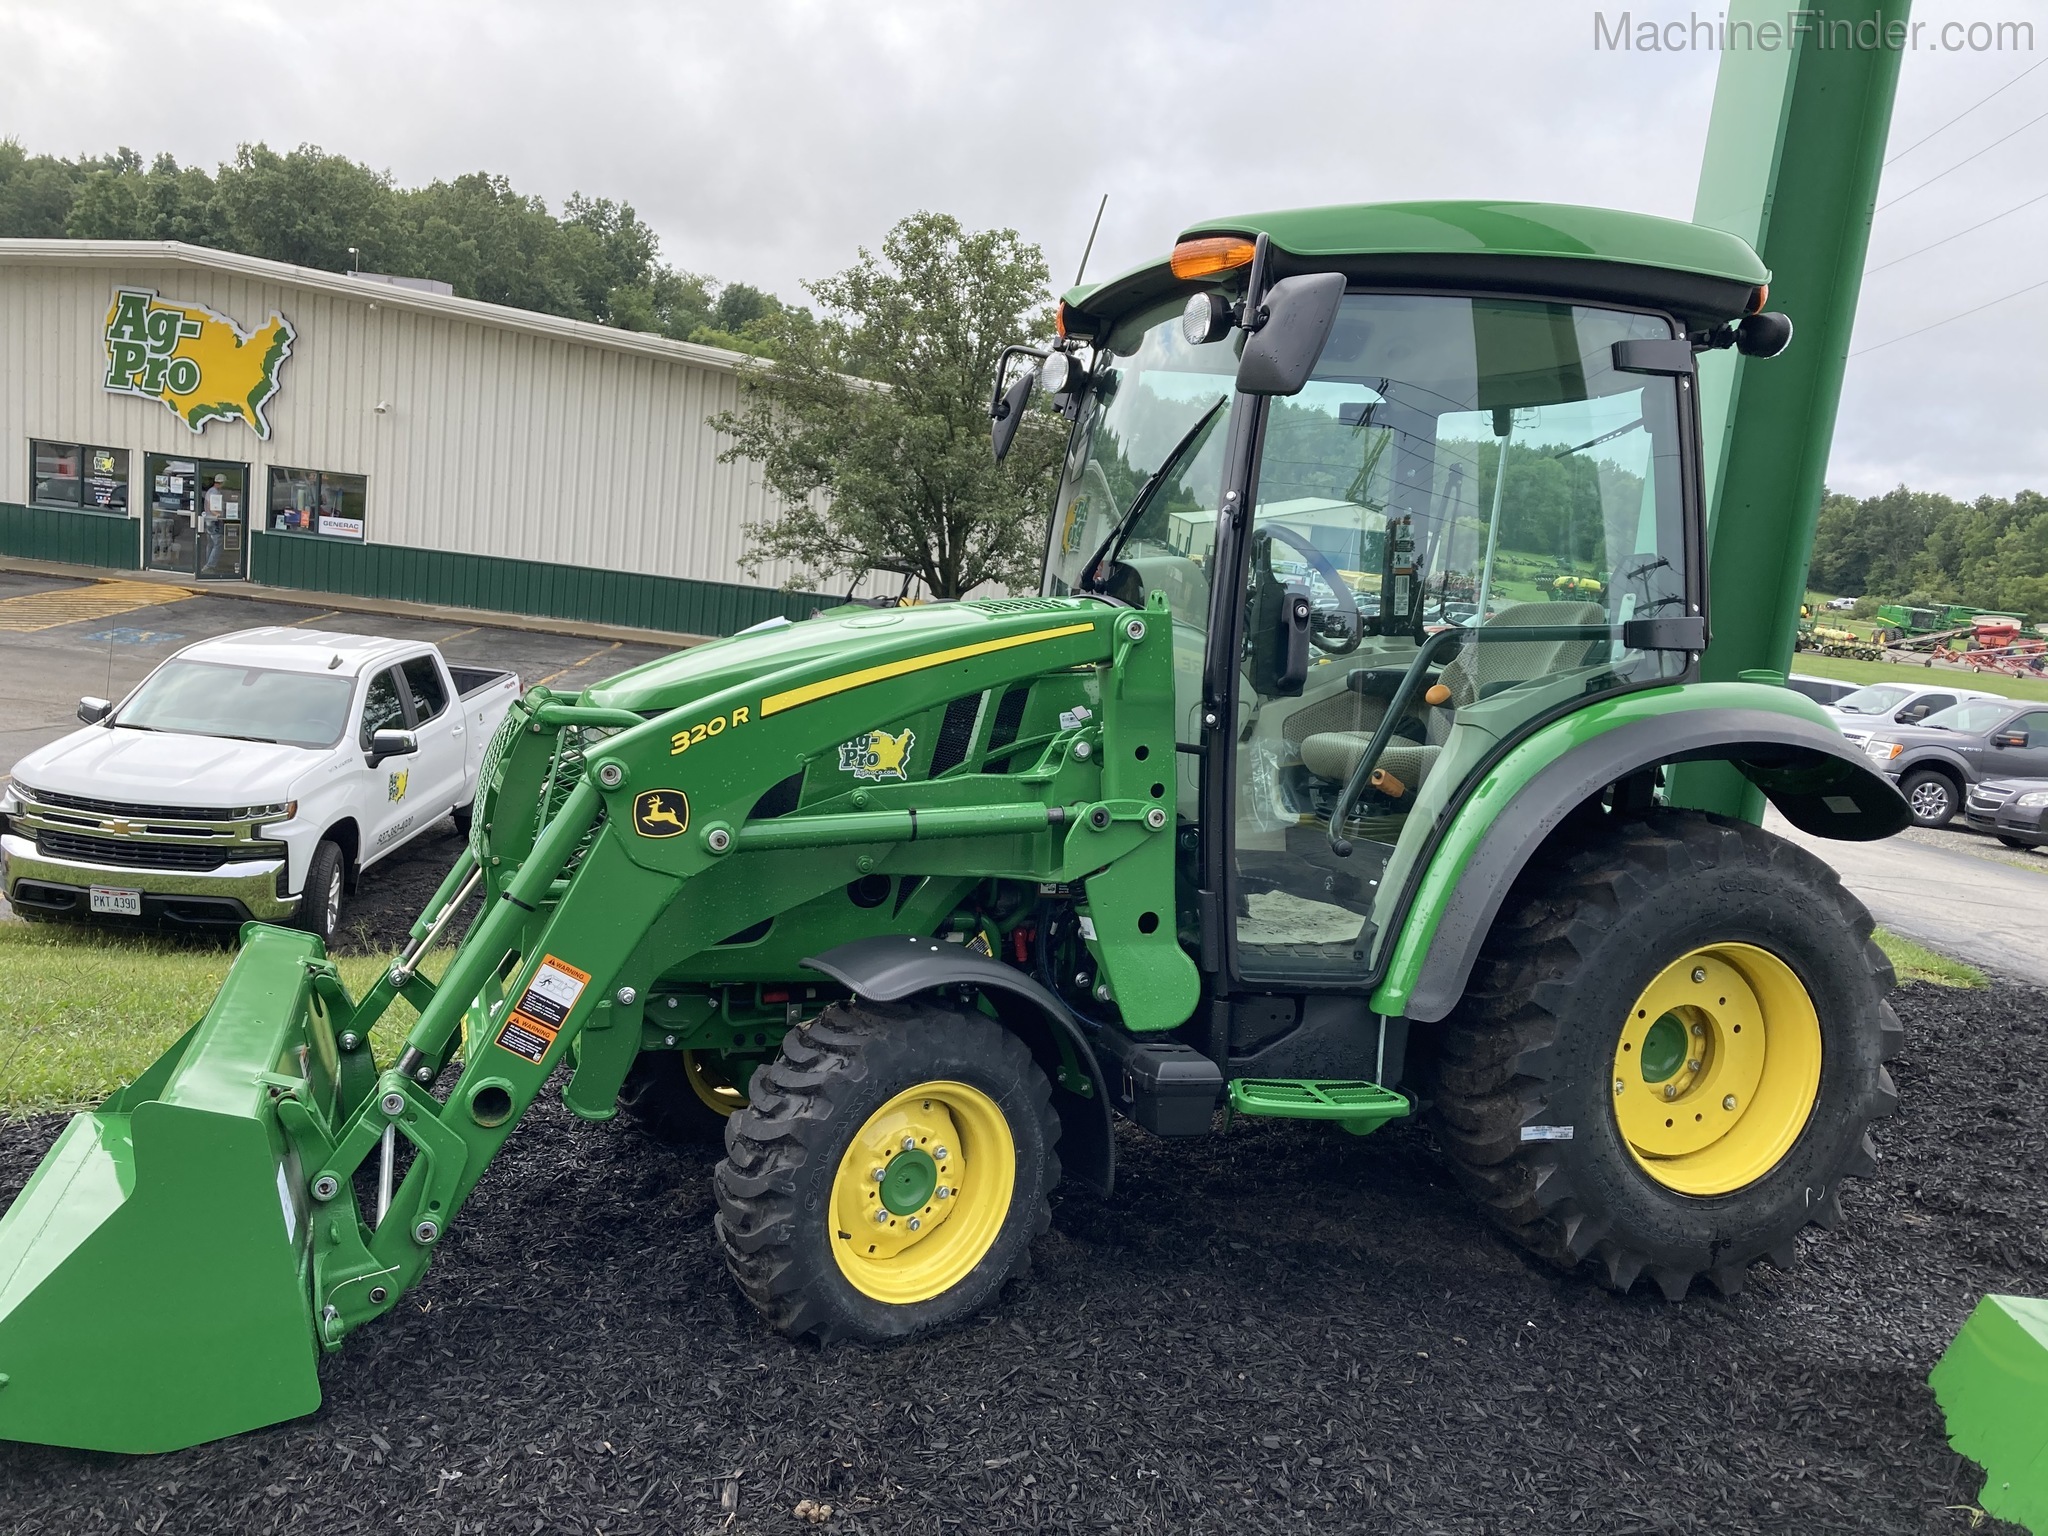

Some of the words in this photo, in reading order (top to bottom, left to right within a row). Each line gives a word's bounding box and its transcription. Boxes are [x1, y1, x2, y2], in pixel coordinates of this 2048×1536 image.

[107, 291, 202, 356] Ag-
[106, 340, 201, 394] Pro
[323, 520, 359, 530] GENERAC
[670, 715, 727, 757] 320
[731, 706, 751, 728] R
[842, 748, 880, 768] Pro
[856, 768, 897, 777] AgProCo.com
[94, 895, 110, 907] PKT
[114, 897, 136, 910] 4390
[556, 962, 585, 980] WARNING
[522, 1020, 551, 1038] WARNING
[804, 1080, 878, 1211] GALAXY
